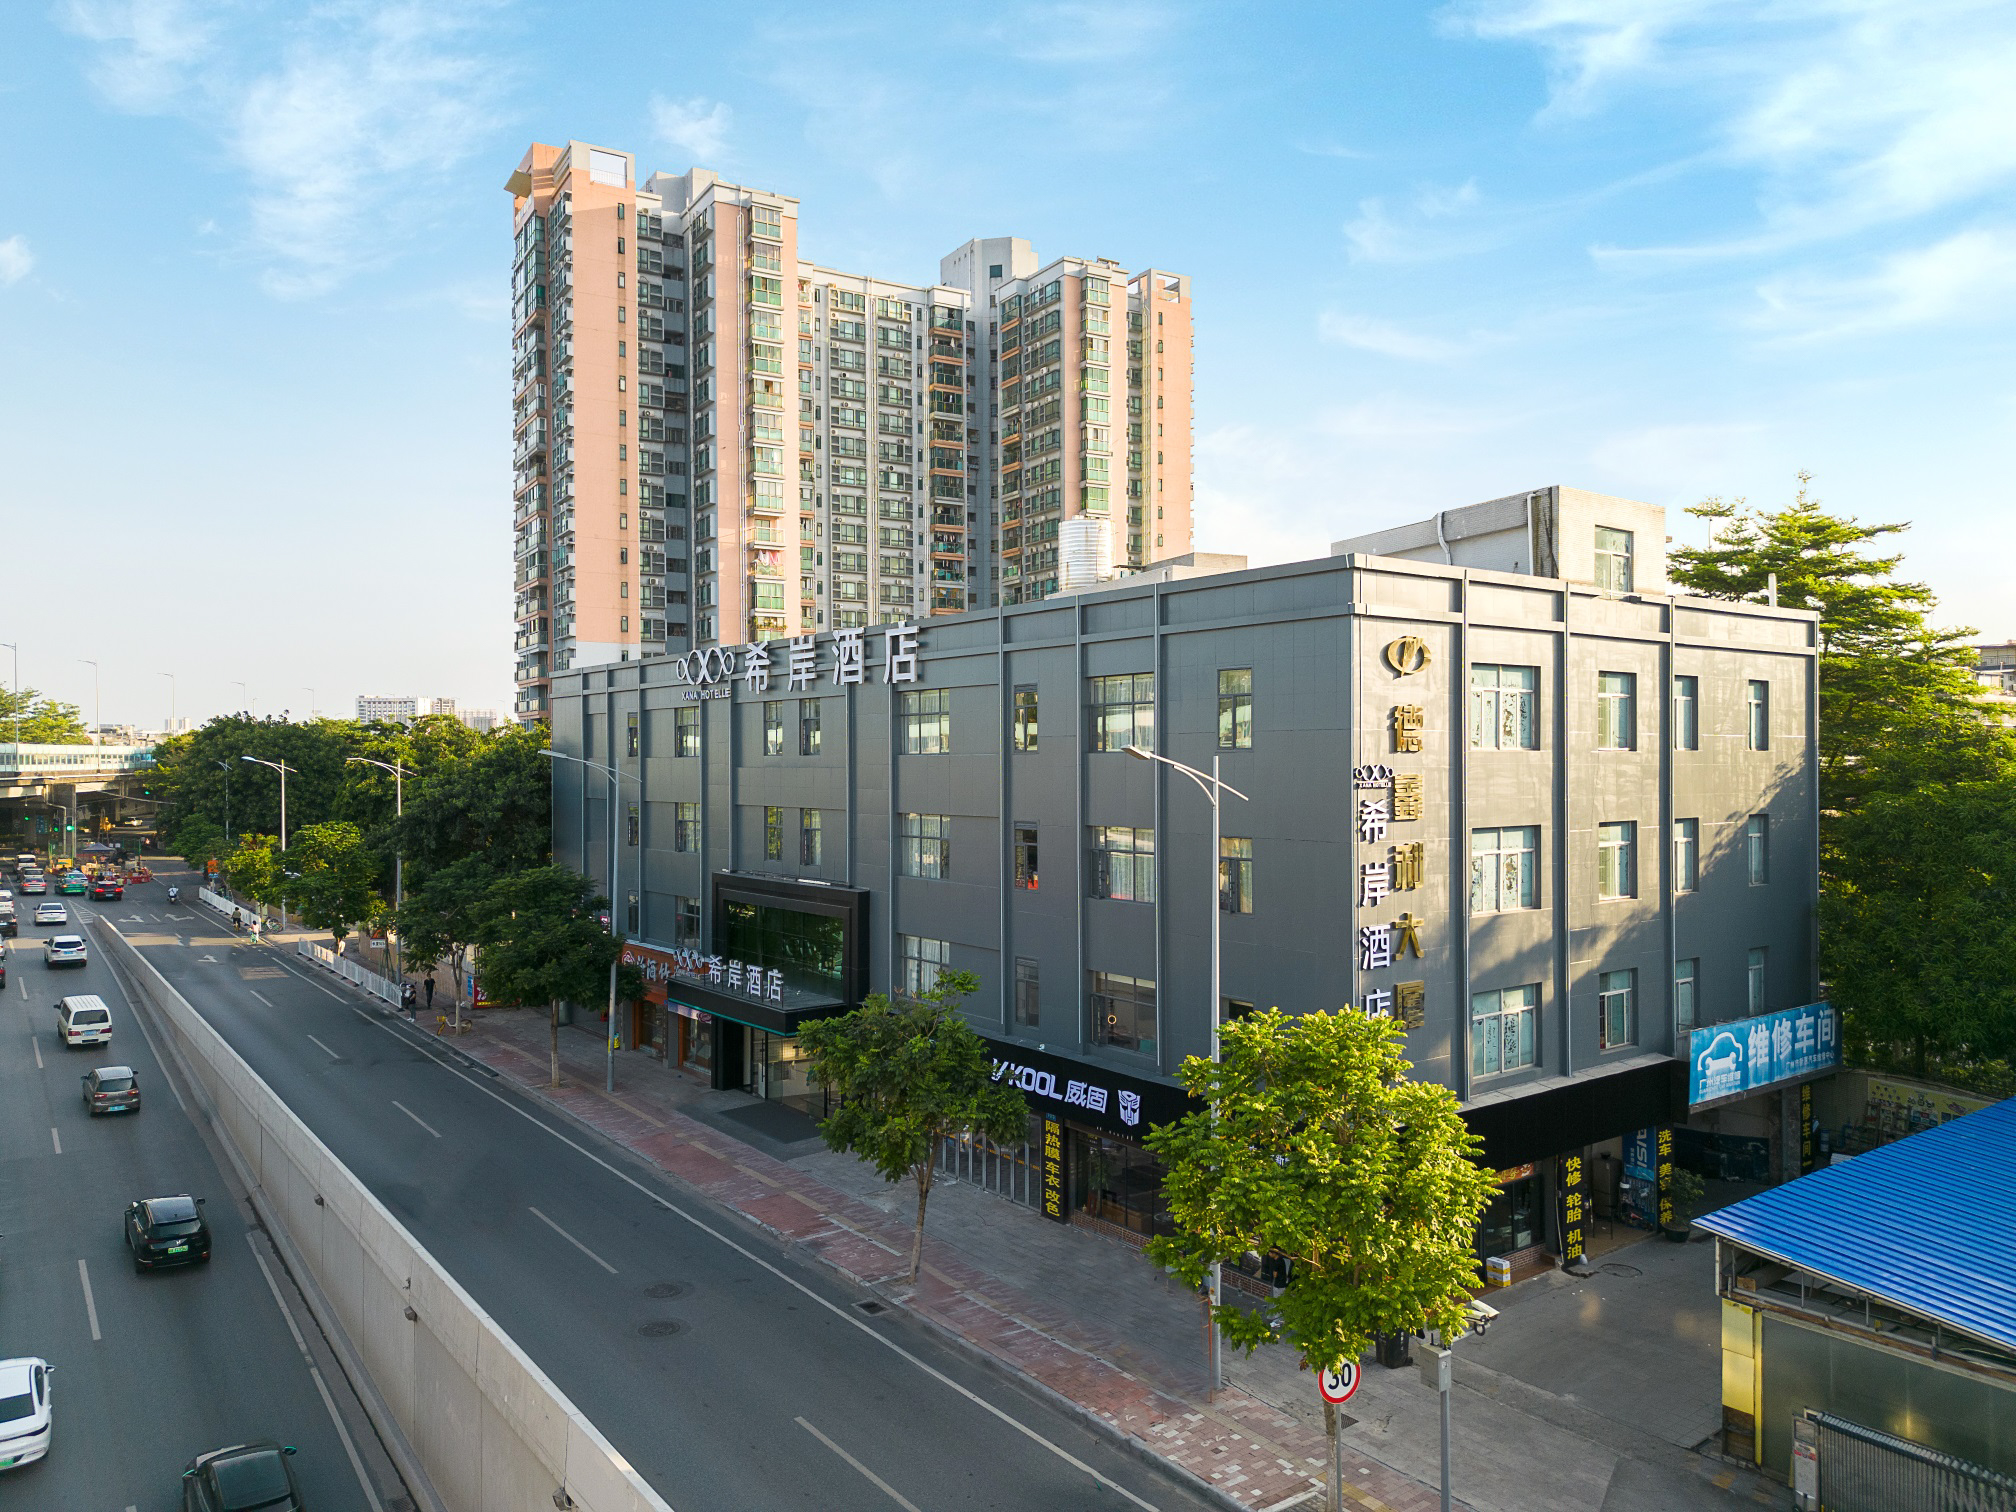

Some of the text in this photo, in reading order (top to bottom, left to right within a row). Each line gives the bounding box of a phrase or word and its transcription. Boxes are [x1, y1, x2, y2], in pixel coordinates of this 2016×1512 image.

[745, 621, 919, 695] 希岸酒店
[1360, 799, 1391, 1021] 希岸酒店
[708, 954, 784, 1001] 希岸酒店
[1748, 1008, 1836, 1067] 维修车间
[1064, 1080, 1108, 1113] 威固
[1045, 1120, 1061, 1161] 隔热膜
[1658, 1129, 1672, 1156] 洗车
[1045, 1161, 1061, 1188] 车衣
[1045, 1188, 1061, 1217] 改色
[1565, 1156, 1583, 1260] 快修 轮胎 机油
[1328, 1362, 1352, 1390] 30
